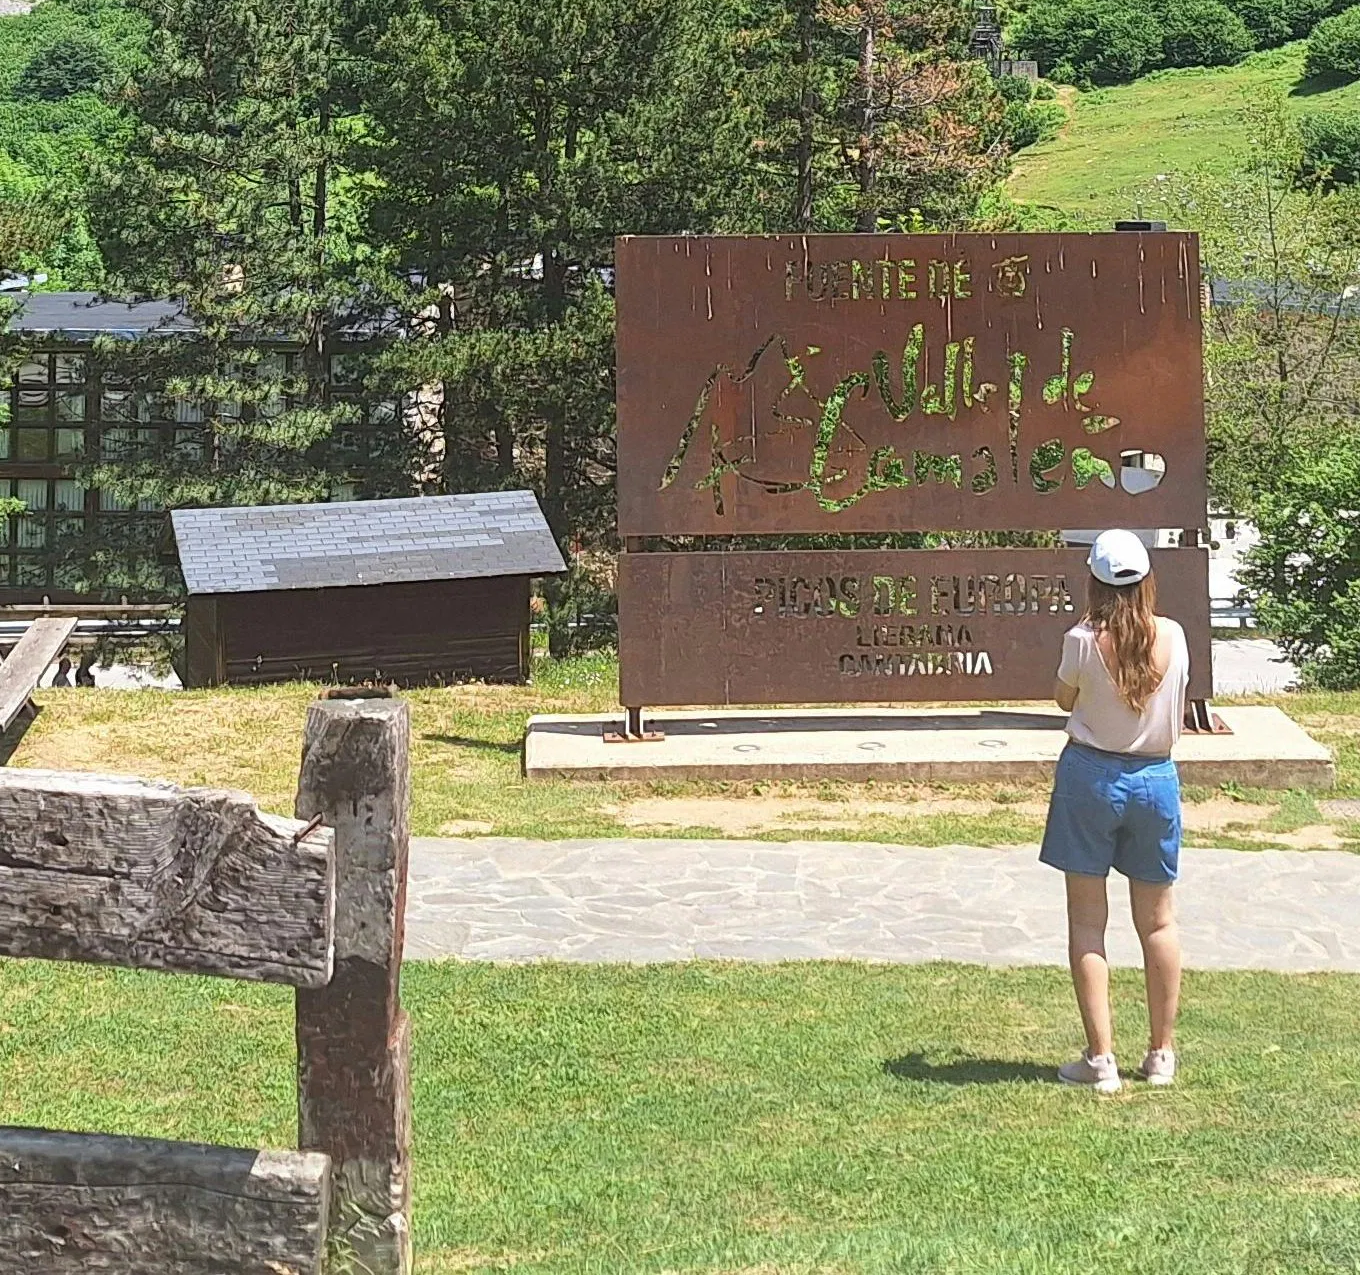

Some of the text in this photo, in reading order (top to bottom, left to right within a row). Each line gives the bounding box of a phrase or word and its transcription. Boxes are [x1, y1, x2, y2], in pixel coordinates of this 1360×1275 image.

[872, 323, 1096, 422] Valle de
[810, 352, 1167, 512] Camaleño
[752, 573, 1074, 618] PICOS DE EUROPA
[839, 650, 994, 676] CANTABRIA
